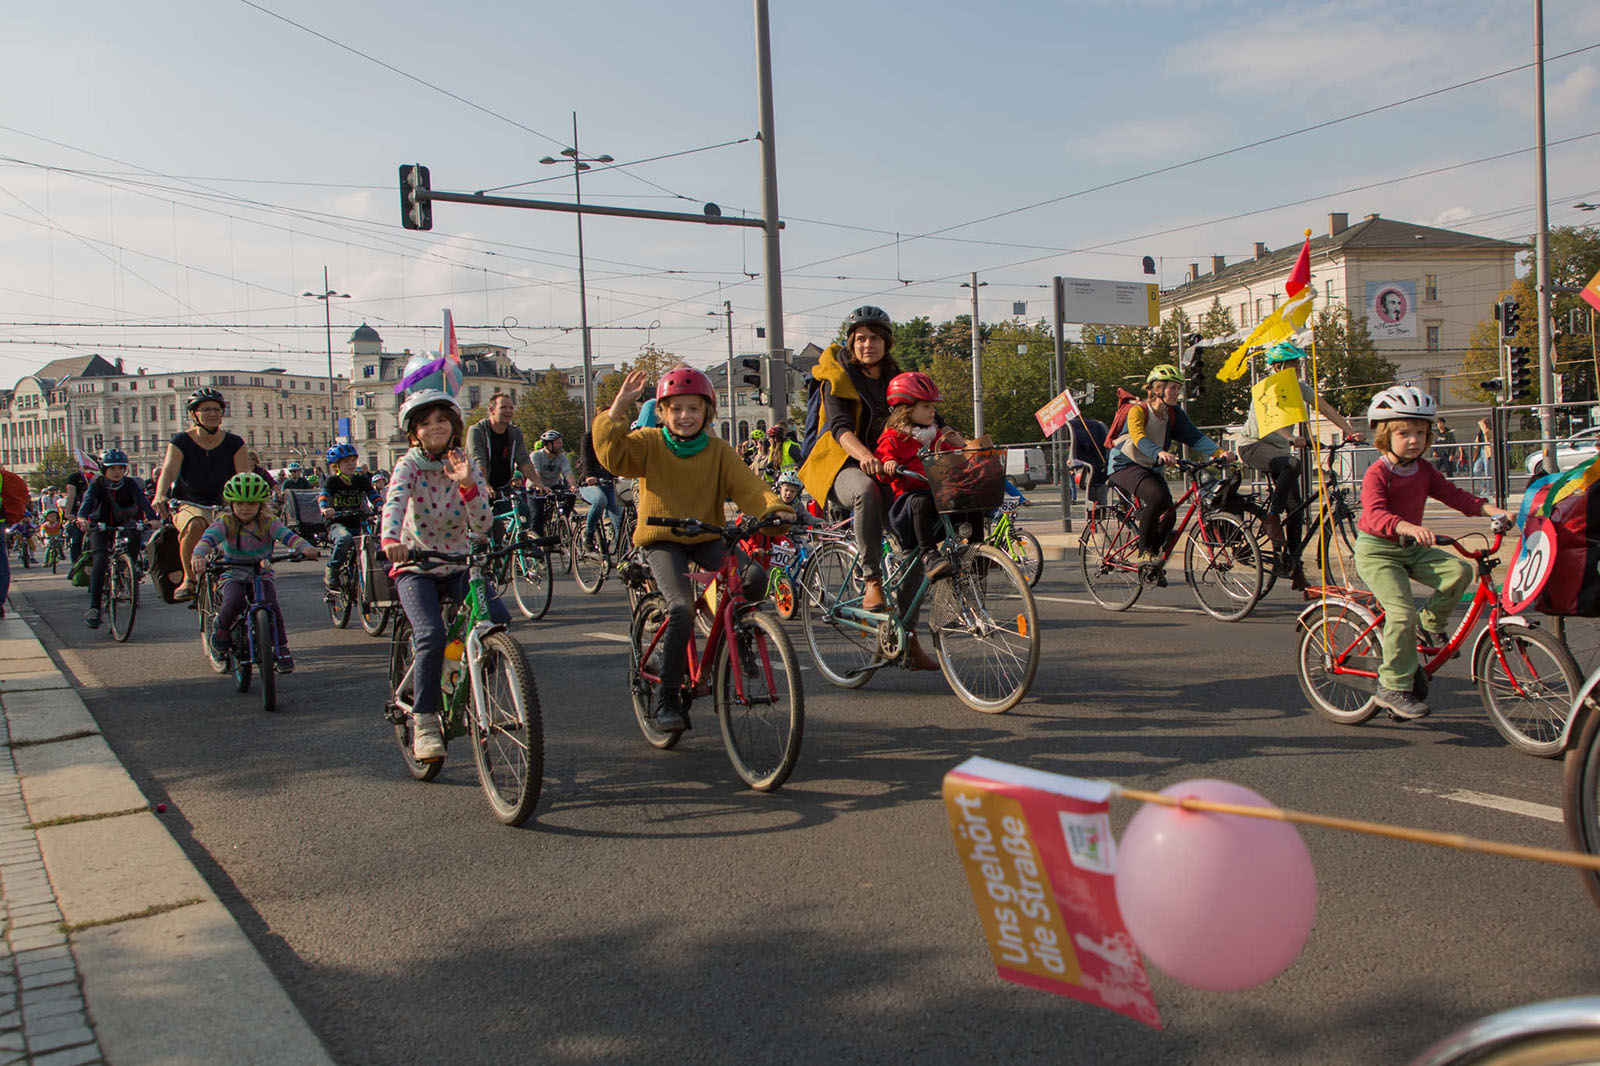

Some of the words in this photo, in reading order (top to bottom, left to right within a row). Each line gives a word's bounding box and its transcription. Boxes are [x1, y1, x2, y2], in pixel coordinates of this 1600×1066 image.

[1151, 292, 1157, 301] D
[1512, 549, 1542, 592] 30
[955, 793, 1018, 903] gehört
[1001, 815, 1051, 921] Straße
[995, 907, 1029, 964] Uns
[1029, 925, 1066, 974] die
